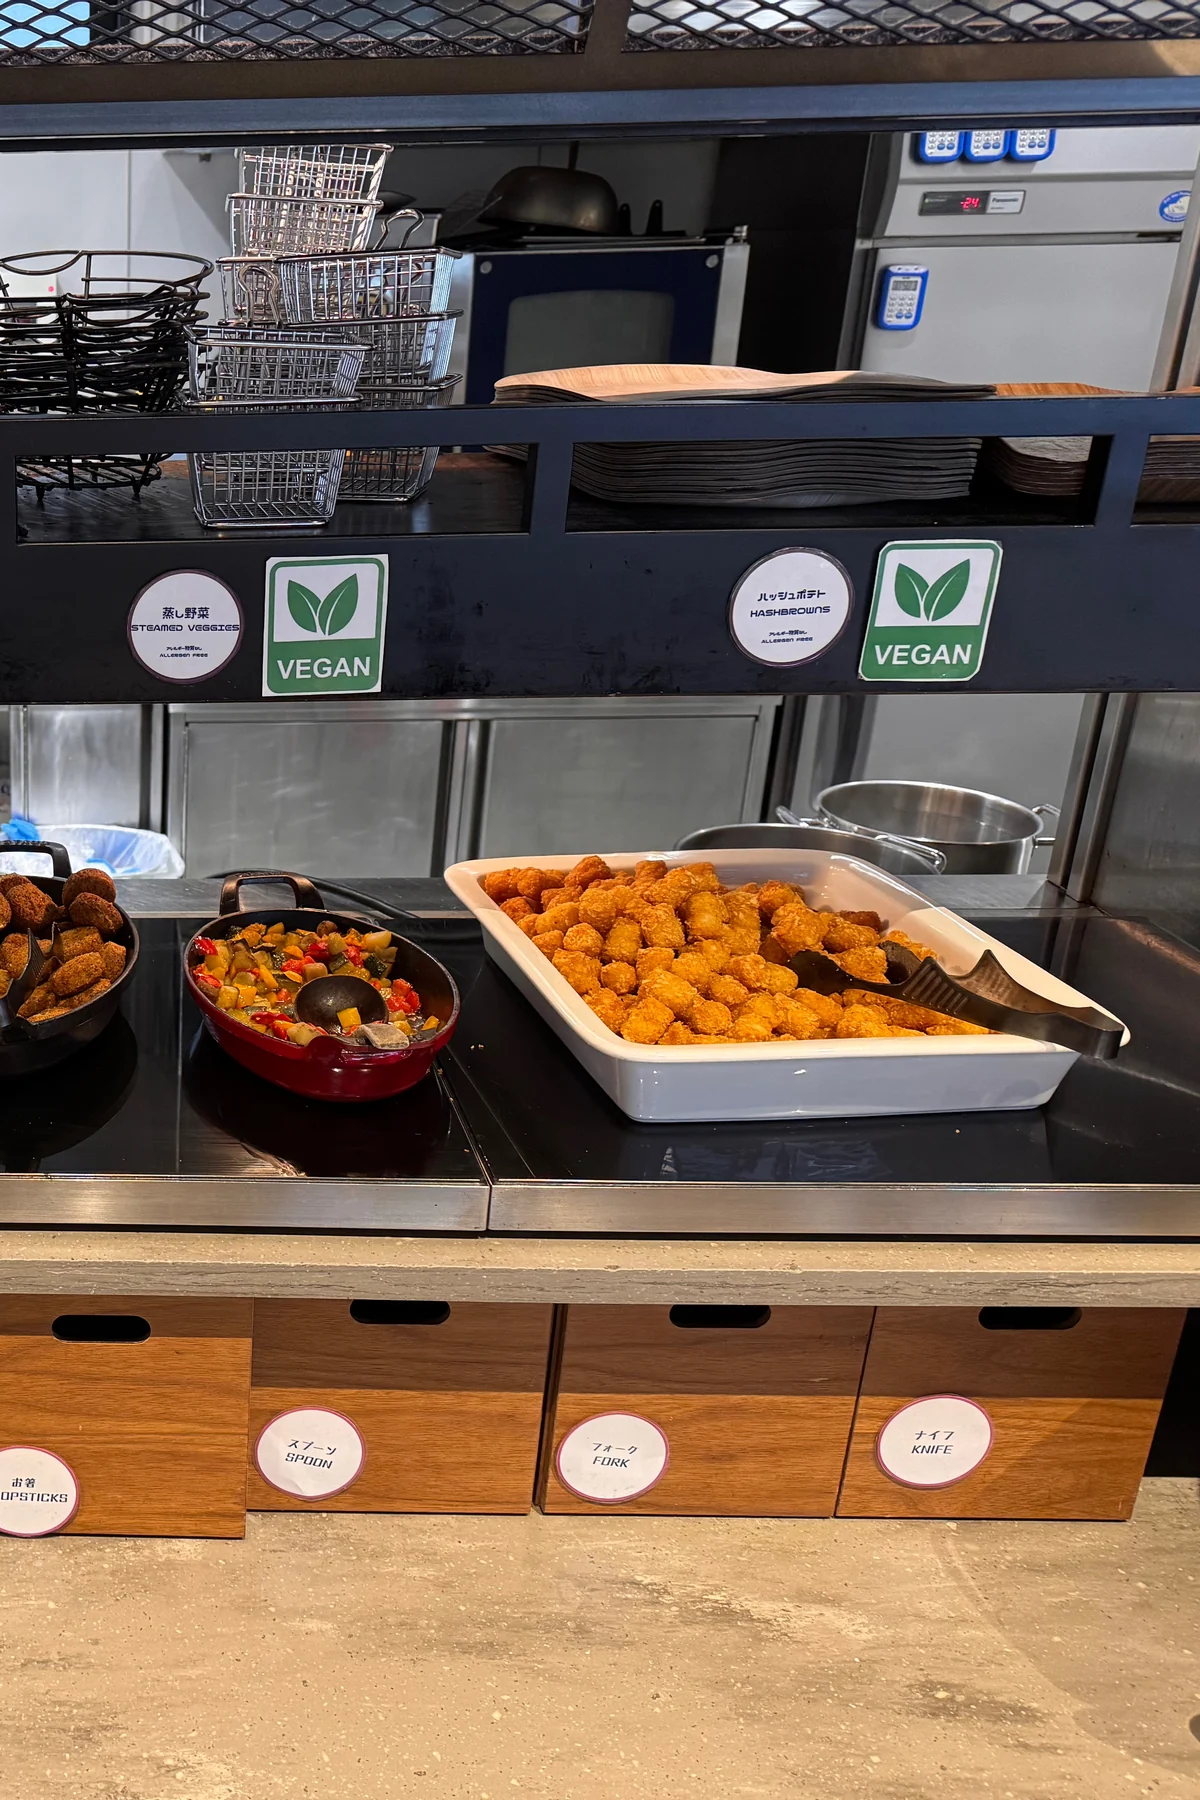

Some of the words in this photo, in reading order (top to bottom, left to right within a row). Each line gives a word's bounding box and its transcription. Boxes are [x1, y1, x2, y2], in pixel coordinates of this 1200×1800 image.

[757, 589, 826, 602] ハッシュポテト
[162, 606, 210, 620] 蒸し野菜
[750, 605, 831, 618] HASHBROWNS
[131, 624, 184, 632] STEAMED
[187, 624, 240, 632] VEGGIES
[874, 643, 972, 666] VEGAN
[276, 656, 371, 680] VEGAN
[915, 1430, 955, 1441] ナイフ
[287, 1438, 337, 1456] スプーン
[592, 1442, 638, 1455] フォーク
[911, 1444, 954, 1455] KNIFE
[285, 1452, 333, 1469] SPOON
[592, 1455, 630, 1468] FORK
[11, 1477, 36, 1489] お箸
